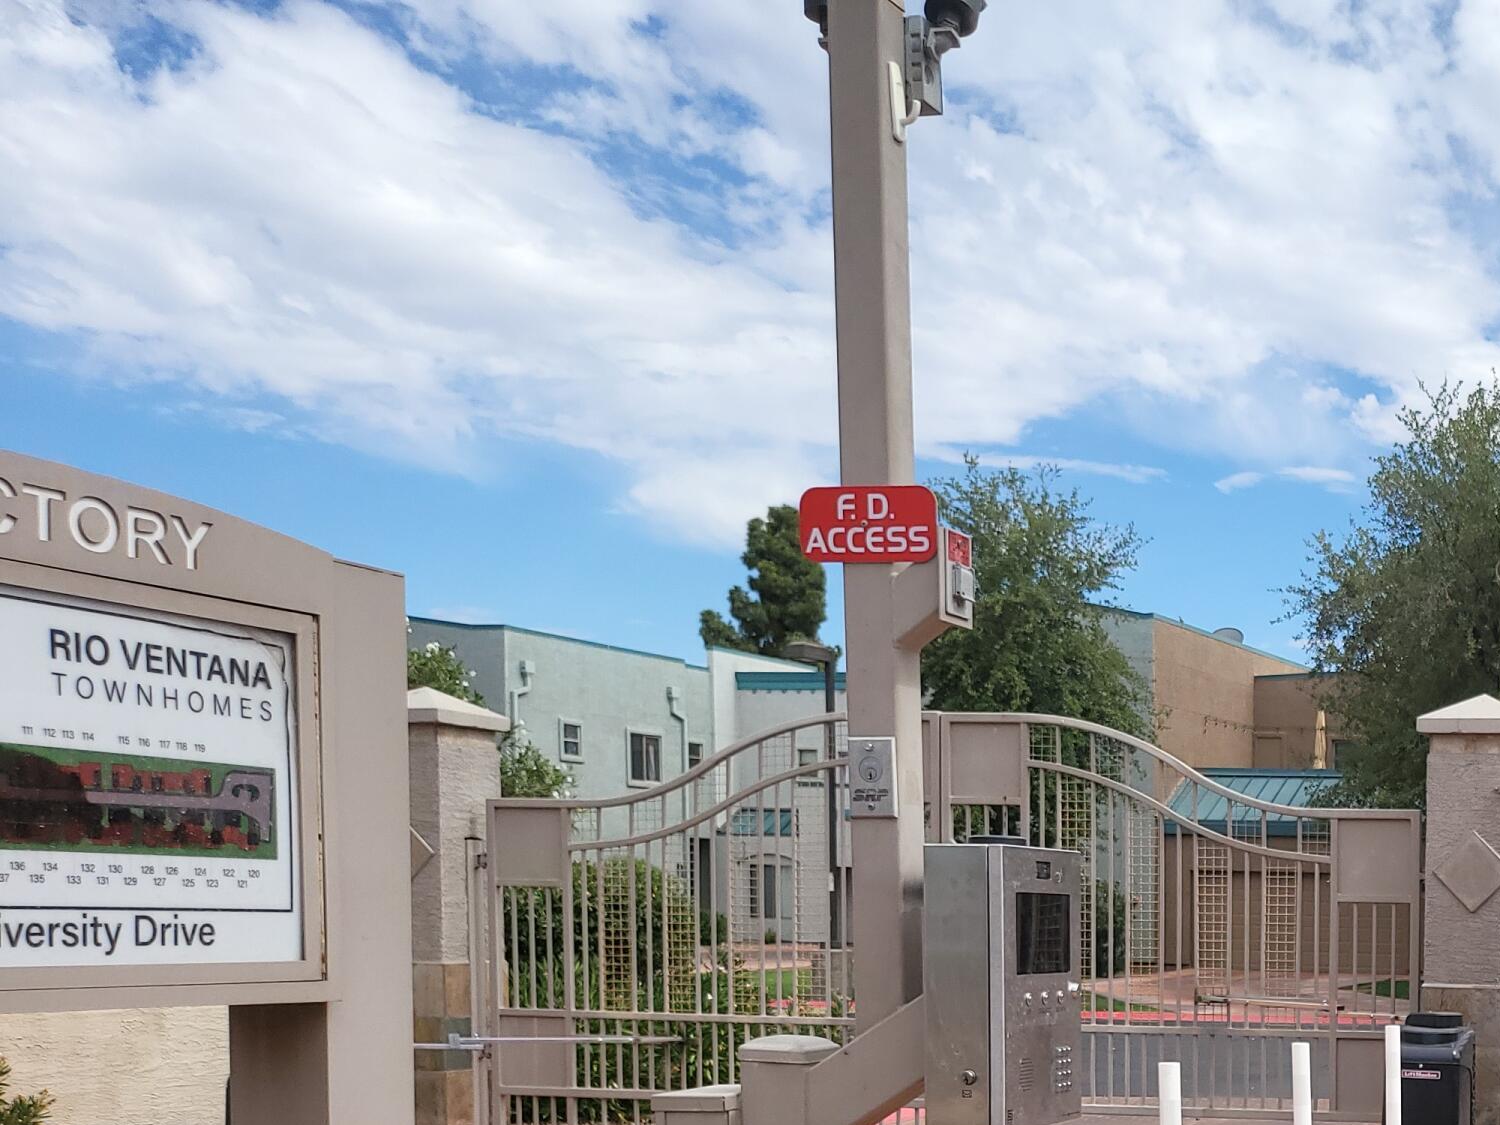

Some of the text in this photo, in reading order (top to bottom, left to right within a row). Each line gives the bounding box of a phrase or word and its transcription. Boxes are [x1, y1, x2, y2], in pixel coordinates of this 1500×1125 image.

[867, 493, 895, 520] D.
[805, 526, 930, 554] ACCESS
[49, 628, 272, 690] RIO VENTANA
[51, 672, 273, 722] TOWNHOMES
[43, 728, 57, 738] 112
[62, 729, 75, 739] 113
[82, 731, 95, 741] 114
[118, 735, 130, 745] 115
[138, 737, 151, 748] 116
[159, 740, 171, 749] 117
[176, 741, 188, 751] 118
[194, 743, 206, 753] 119
[9, 861, 261, 879] 136 134 132 130 128 126 124 122 120
[29, 874, 46, 884] 135
[66, 875, 82, 885] 133
[97, 876, 110, 886] 131
[123, 877, 138, 886] 129
[153, 877, 166, 887] 127
[182, 878, 196, 888] 125
[206, 879, 219, 888] 123
[237, 880, 248, 889] 121
[0, 912, 216, 956] versity Drive
